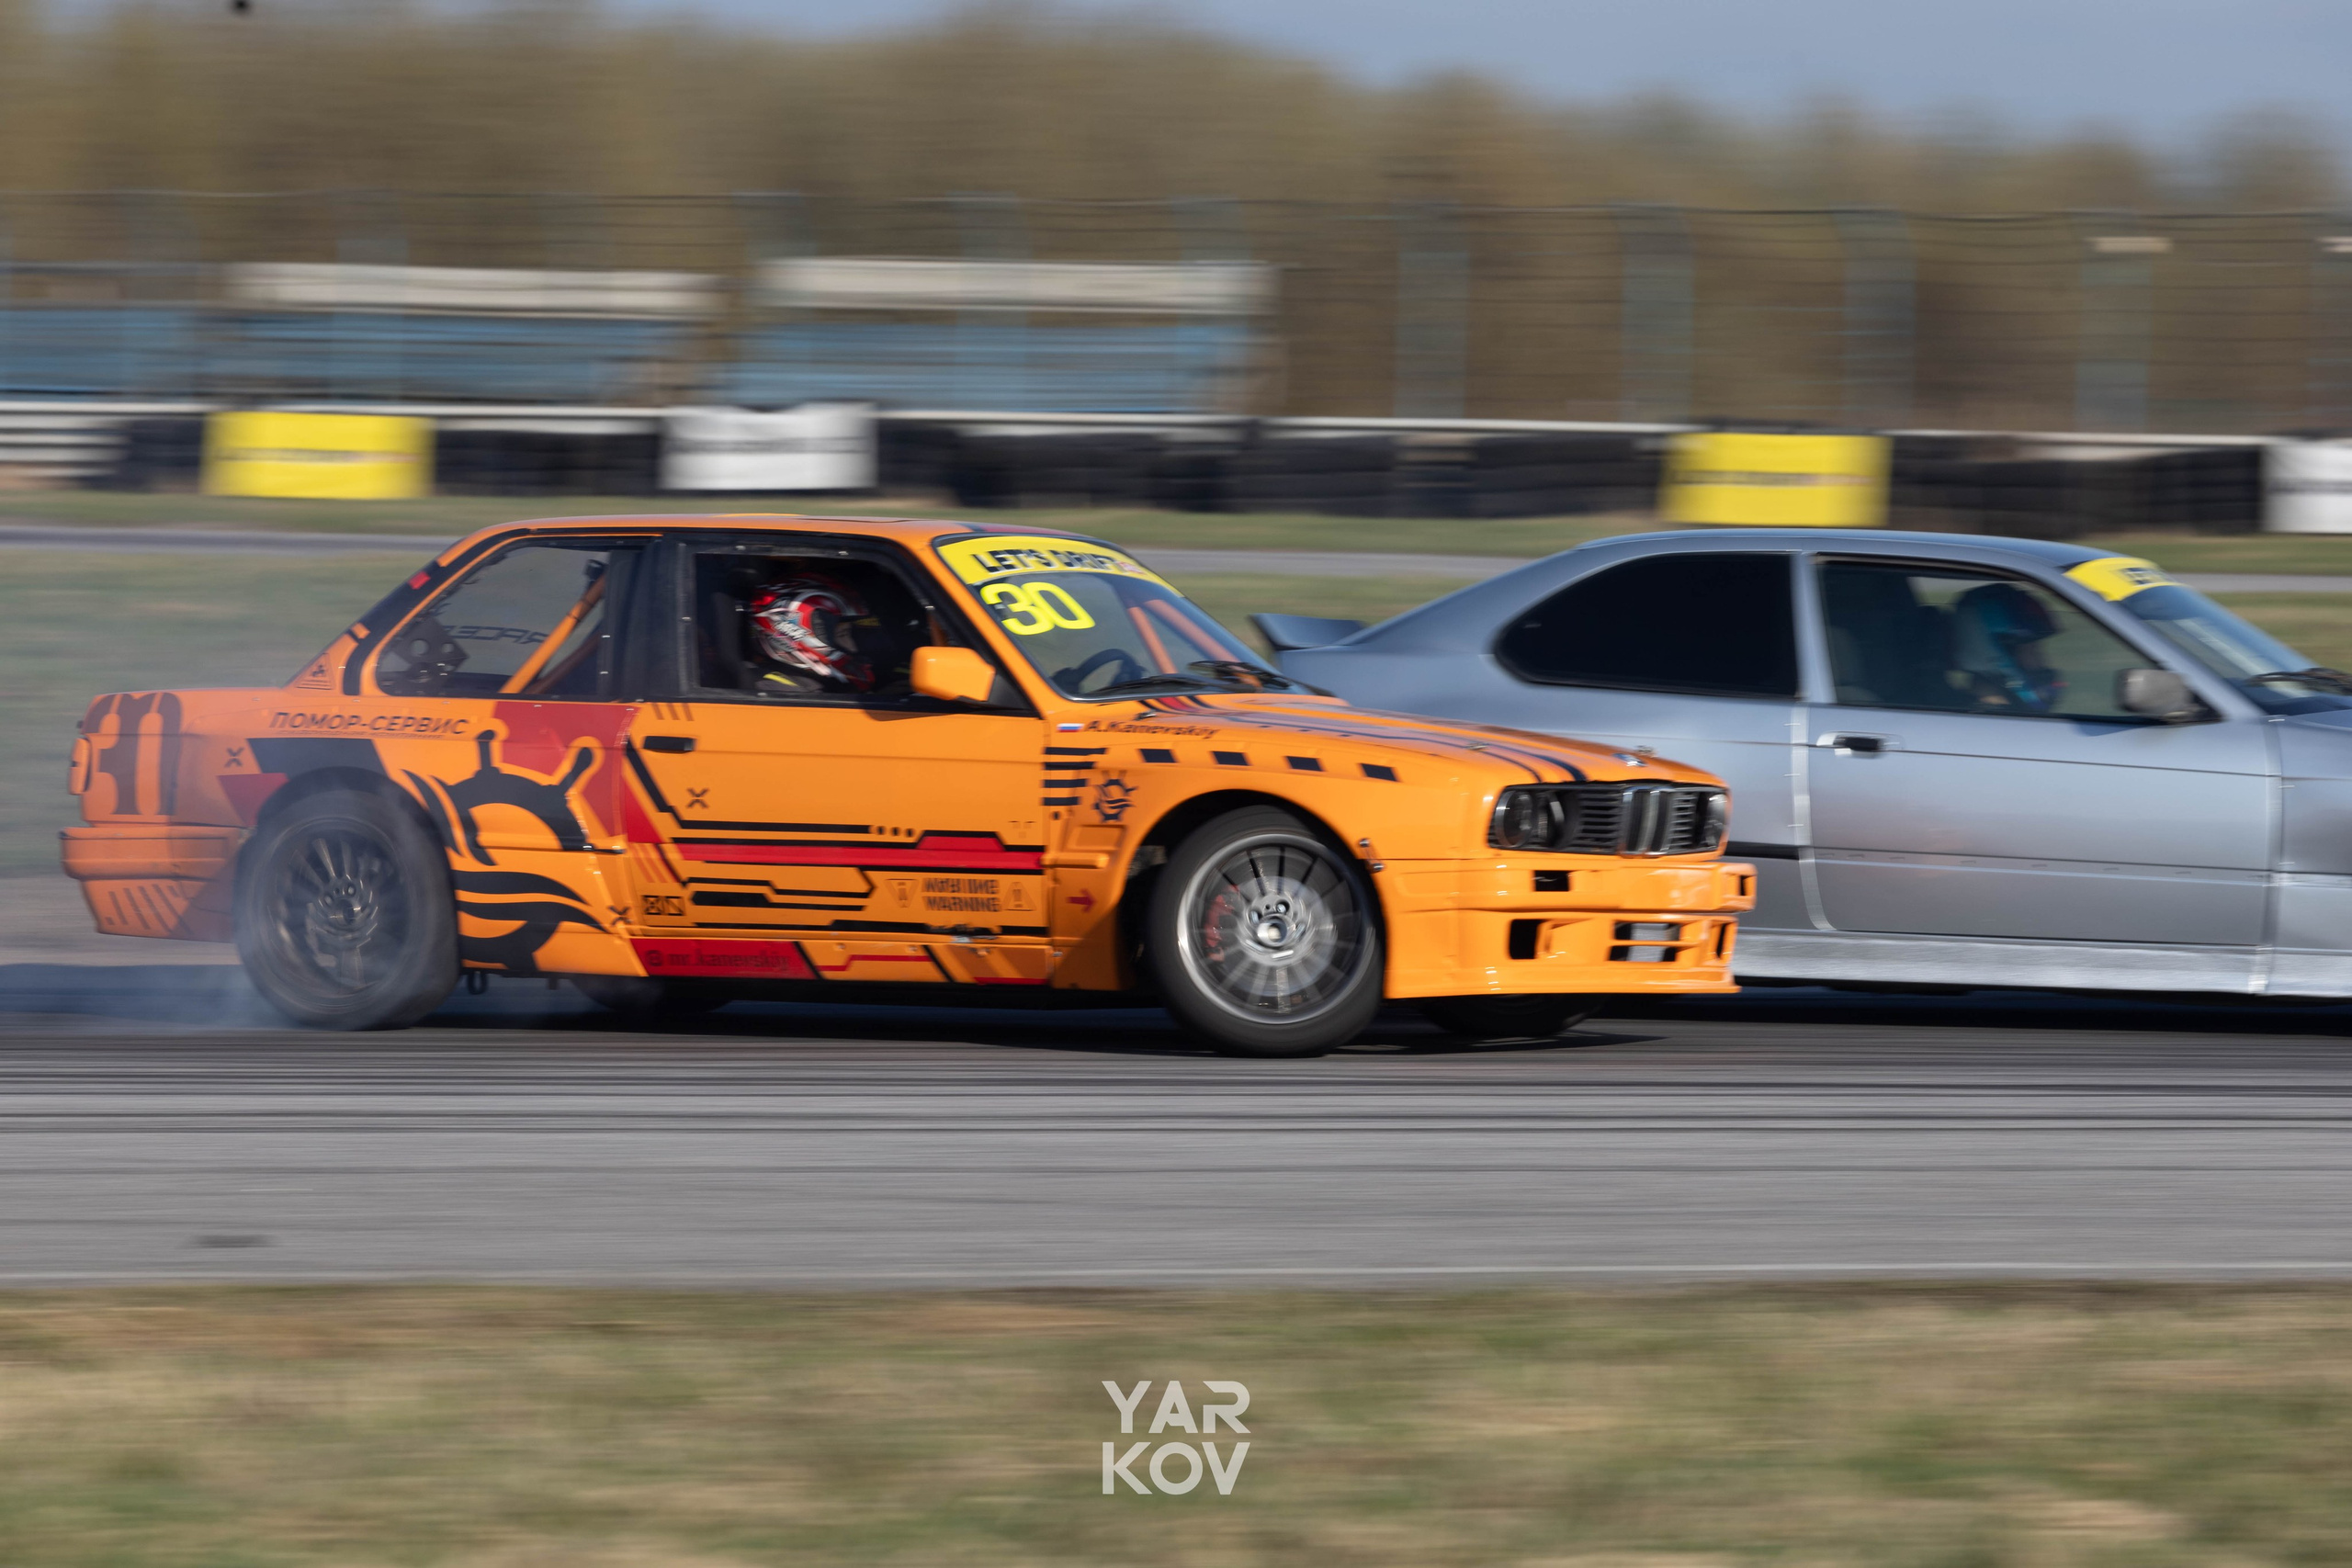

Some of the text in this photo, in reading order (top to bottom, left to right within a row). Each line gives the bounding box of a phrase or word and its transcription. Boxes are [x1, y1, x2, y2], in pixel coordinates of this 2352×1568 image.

[970, 548, 1057, 575] LET'S
[979, 581, 1096, 636] 30
[269, 712, 469, 734] ПОМОР-СЕРВИС
